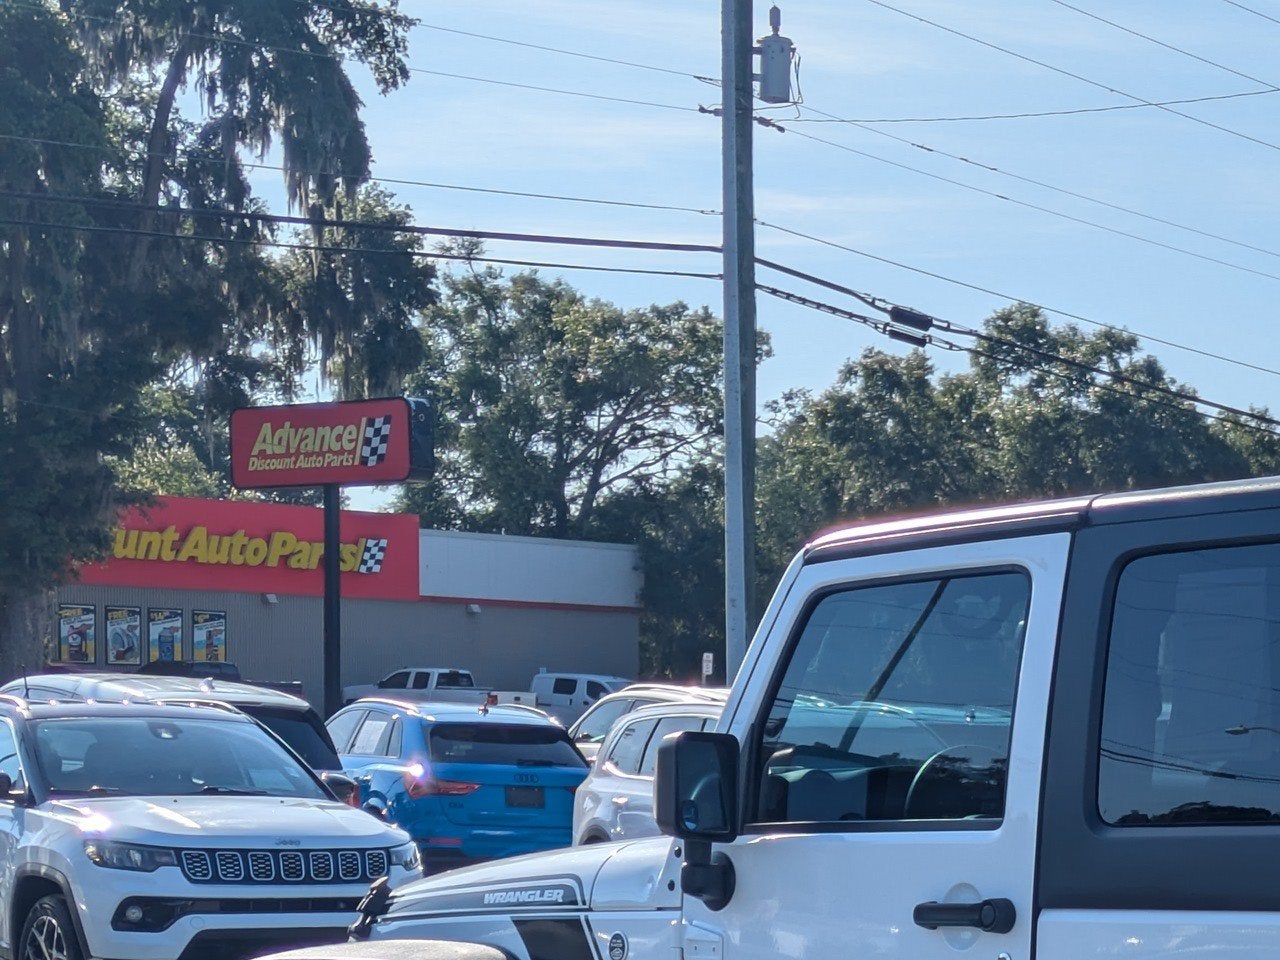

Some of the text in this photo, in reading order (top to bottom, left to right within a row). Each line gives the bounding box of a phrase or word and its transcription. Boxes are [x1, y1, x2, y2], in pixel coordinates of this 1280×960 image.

[251, 421, 357, 455] Advance
[248, 452, 353, 471] Discount Auto Parts
[177, 526, 268, 567] Auto
[267, 531, 356, 573] Pars
[483, 889, 564, 904] WRANGLER
